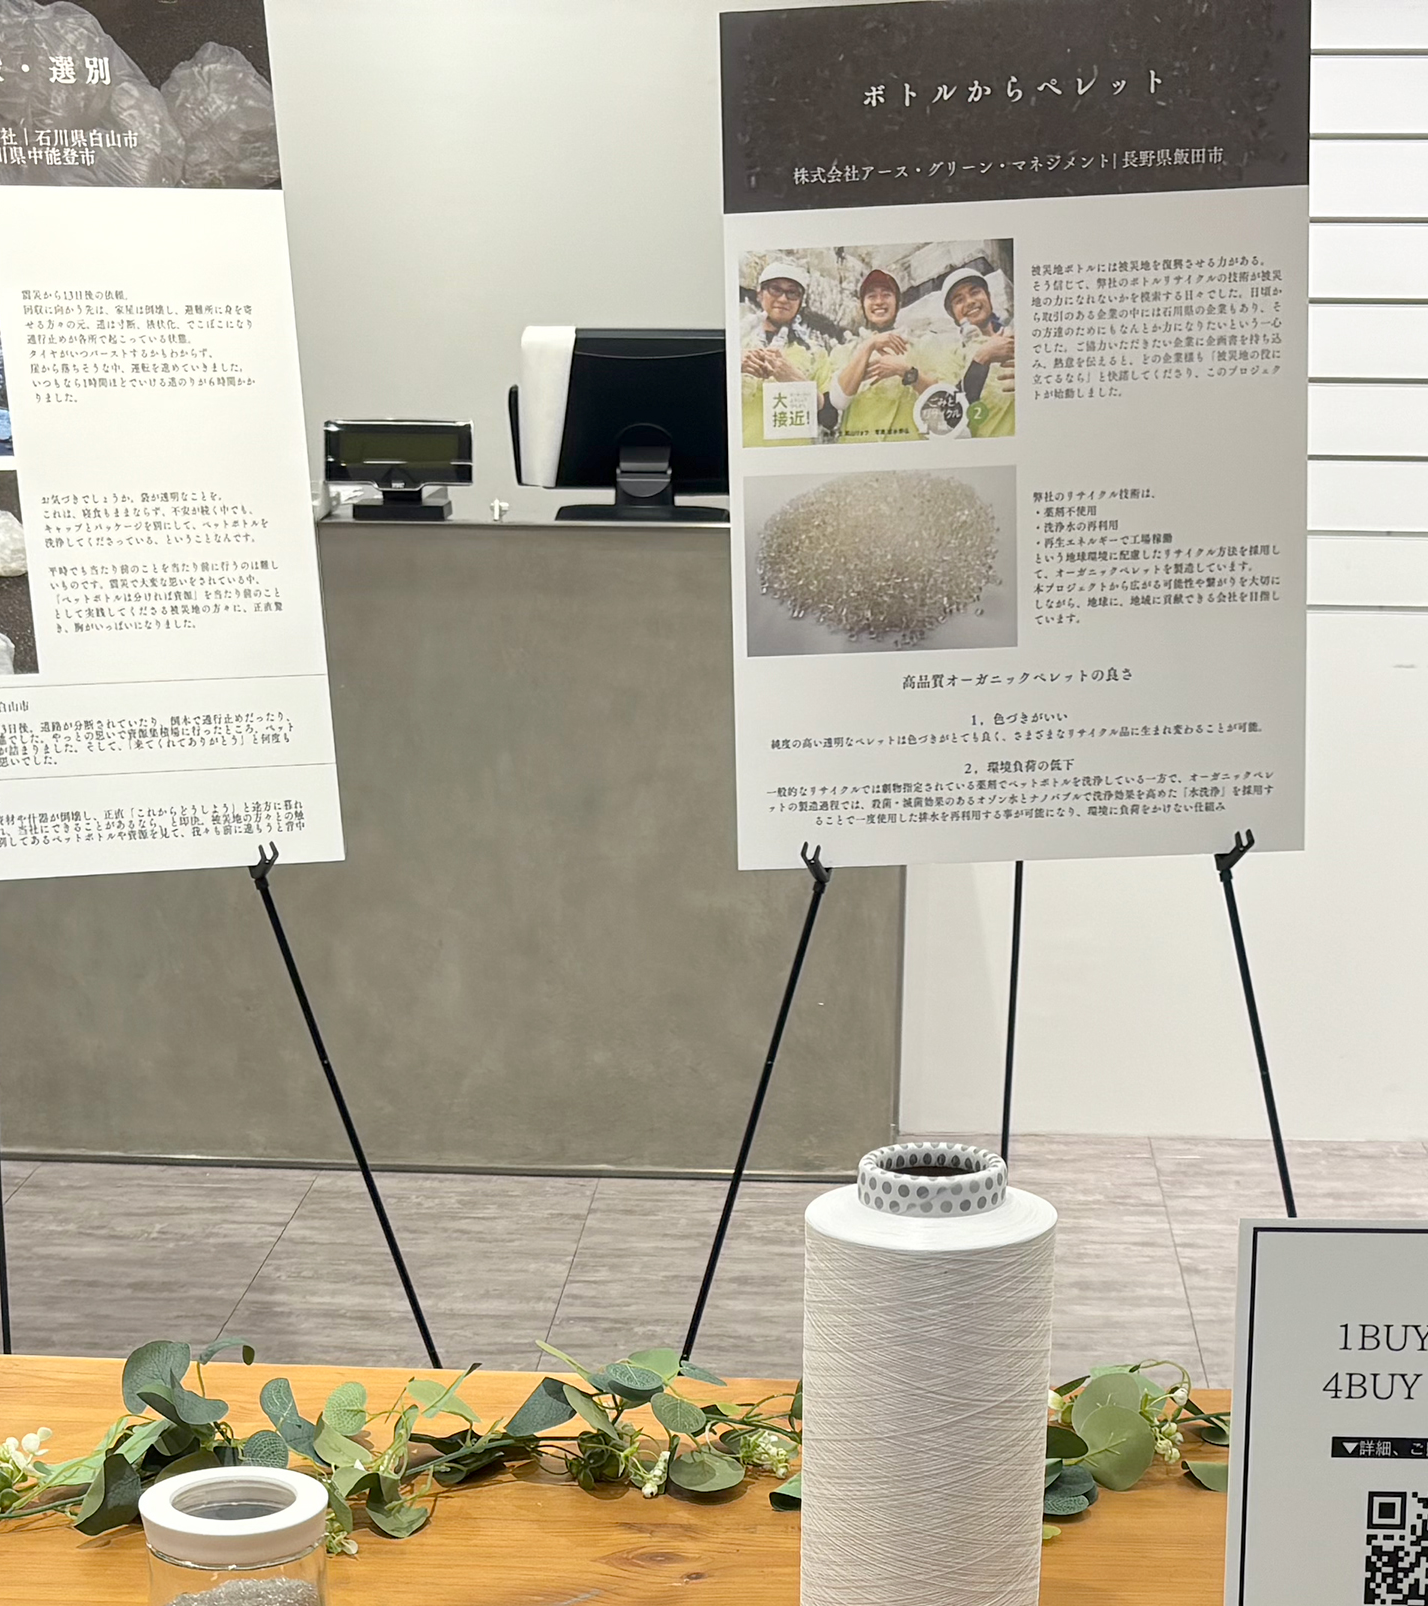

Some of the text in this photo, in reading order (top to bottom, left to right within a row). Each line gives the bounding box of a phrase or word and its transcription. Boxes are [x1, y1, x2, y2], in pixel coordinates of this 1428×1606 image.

[864, 70, 1161, 107] ボトルからペレット
[773, 392, 788, 409] 大
[974, 408, 981, 419] 2
[1035, 614, 1079, 625] ています。
[903, 667, 1132, 689] 高品質オーガニックペレットの良さ
[1322, 1373, 1422, 1400] 4BUY
